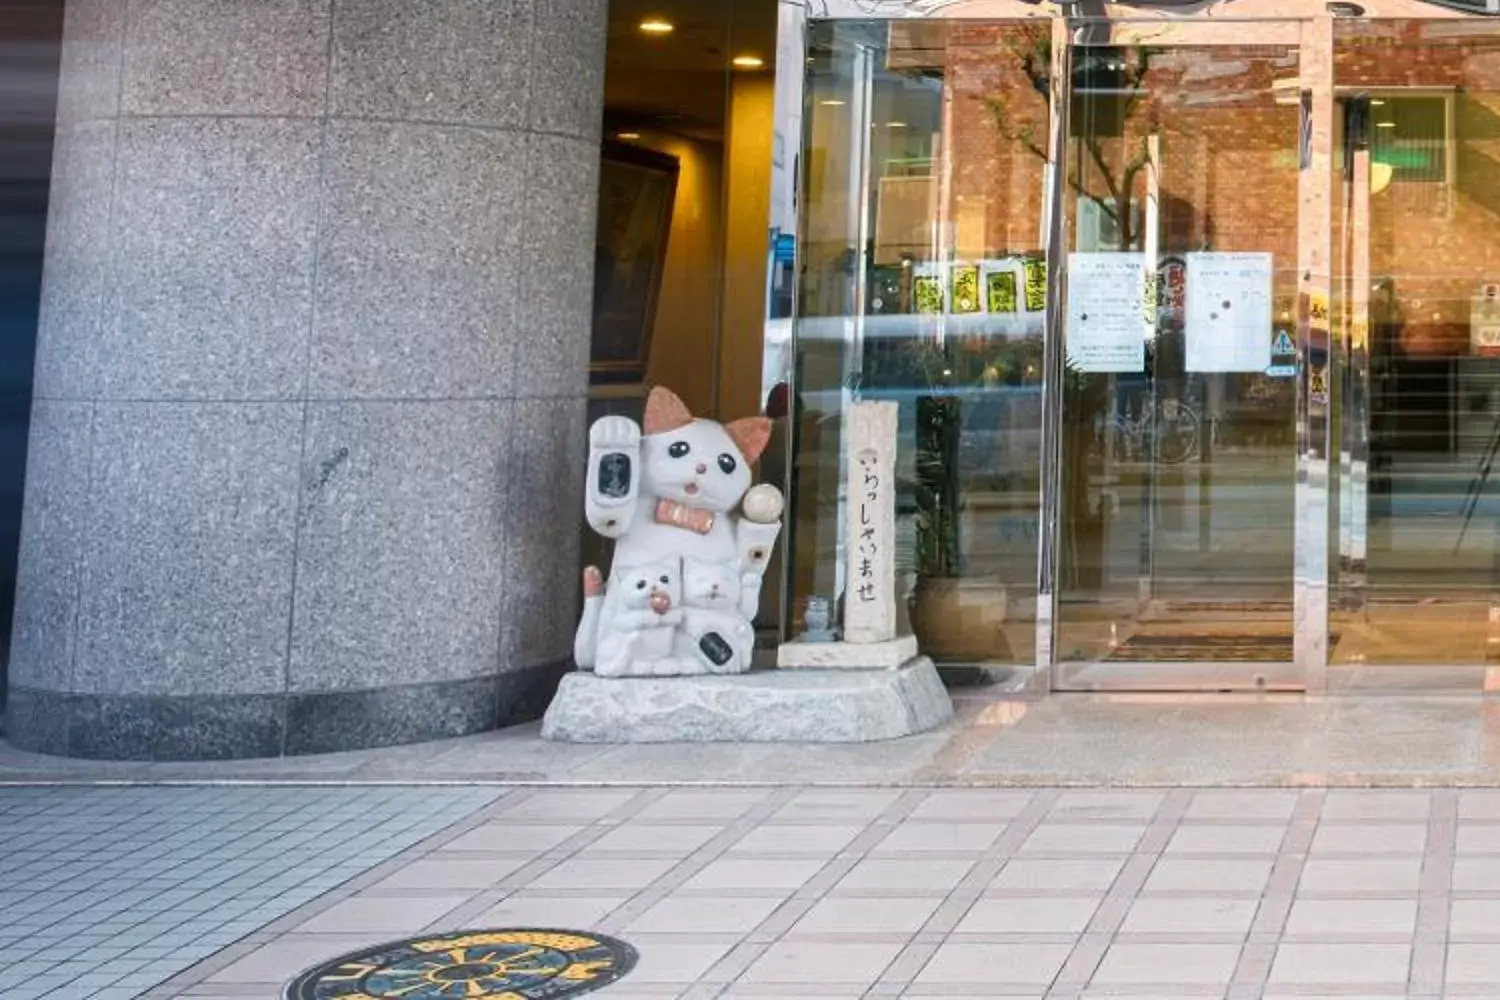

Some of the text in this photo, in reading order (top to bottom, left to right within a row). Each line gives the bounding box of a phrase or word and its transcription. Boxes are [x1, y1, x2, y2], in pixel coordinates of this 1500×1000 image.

[857, 454, 880, 602] いらっしゃいませ
